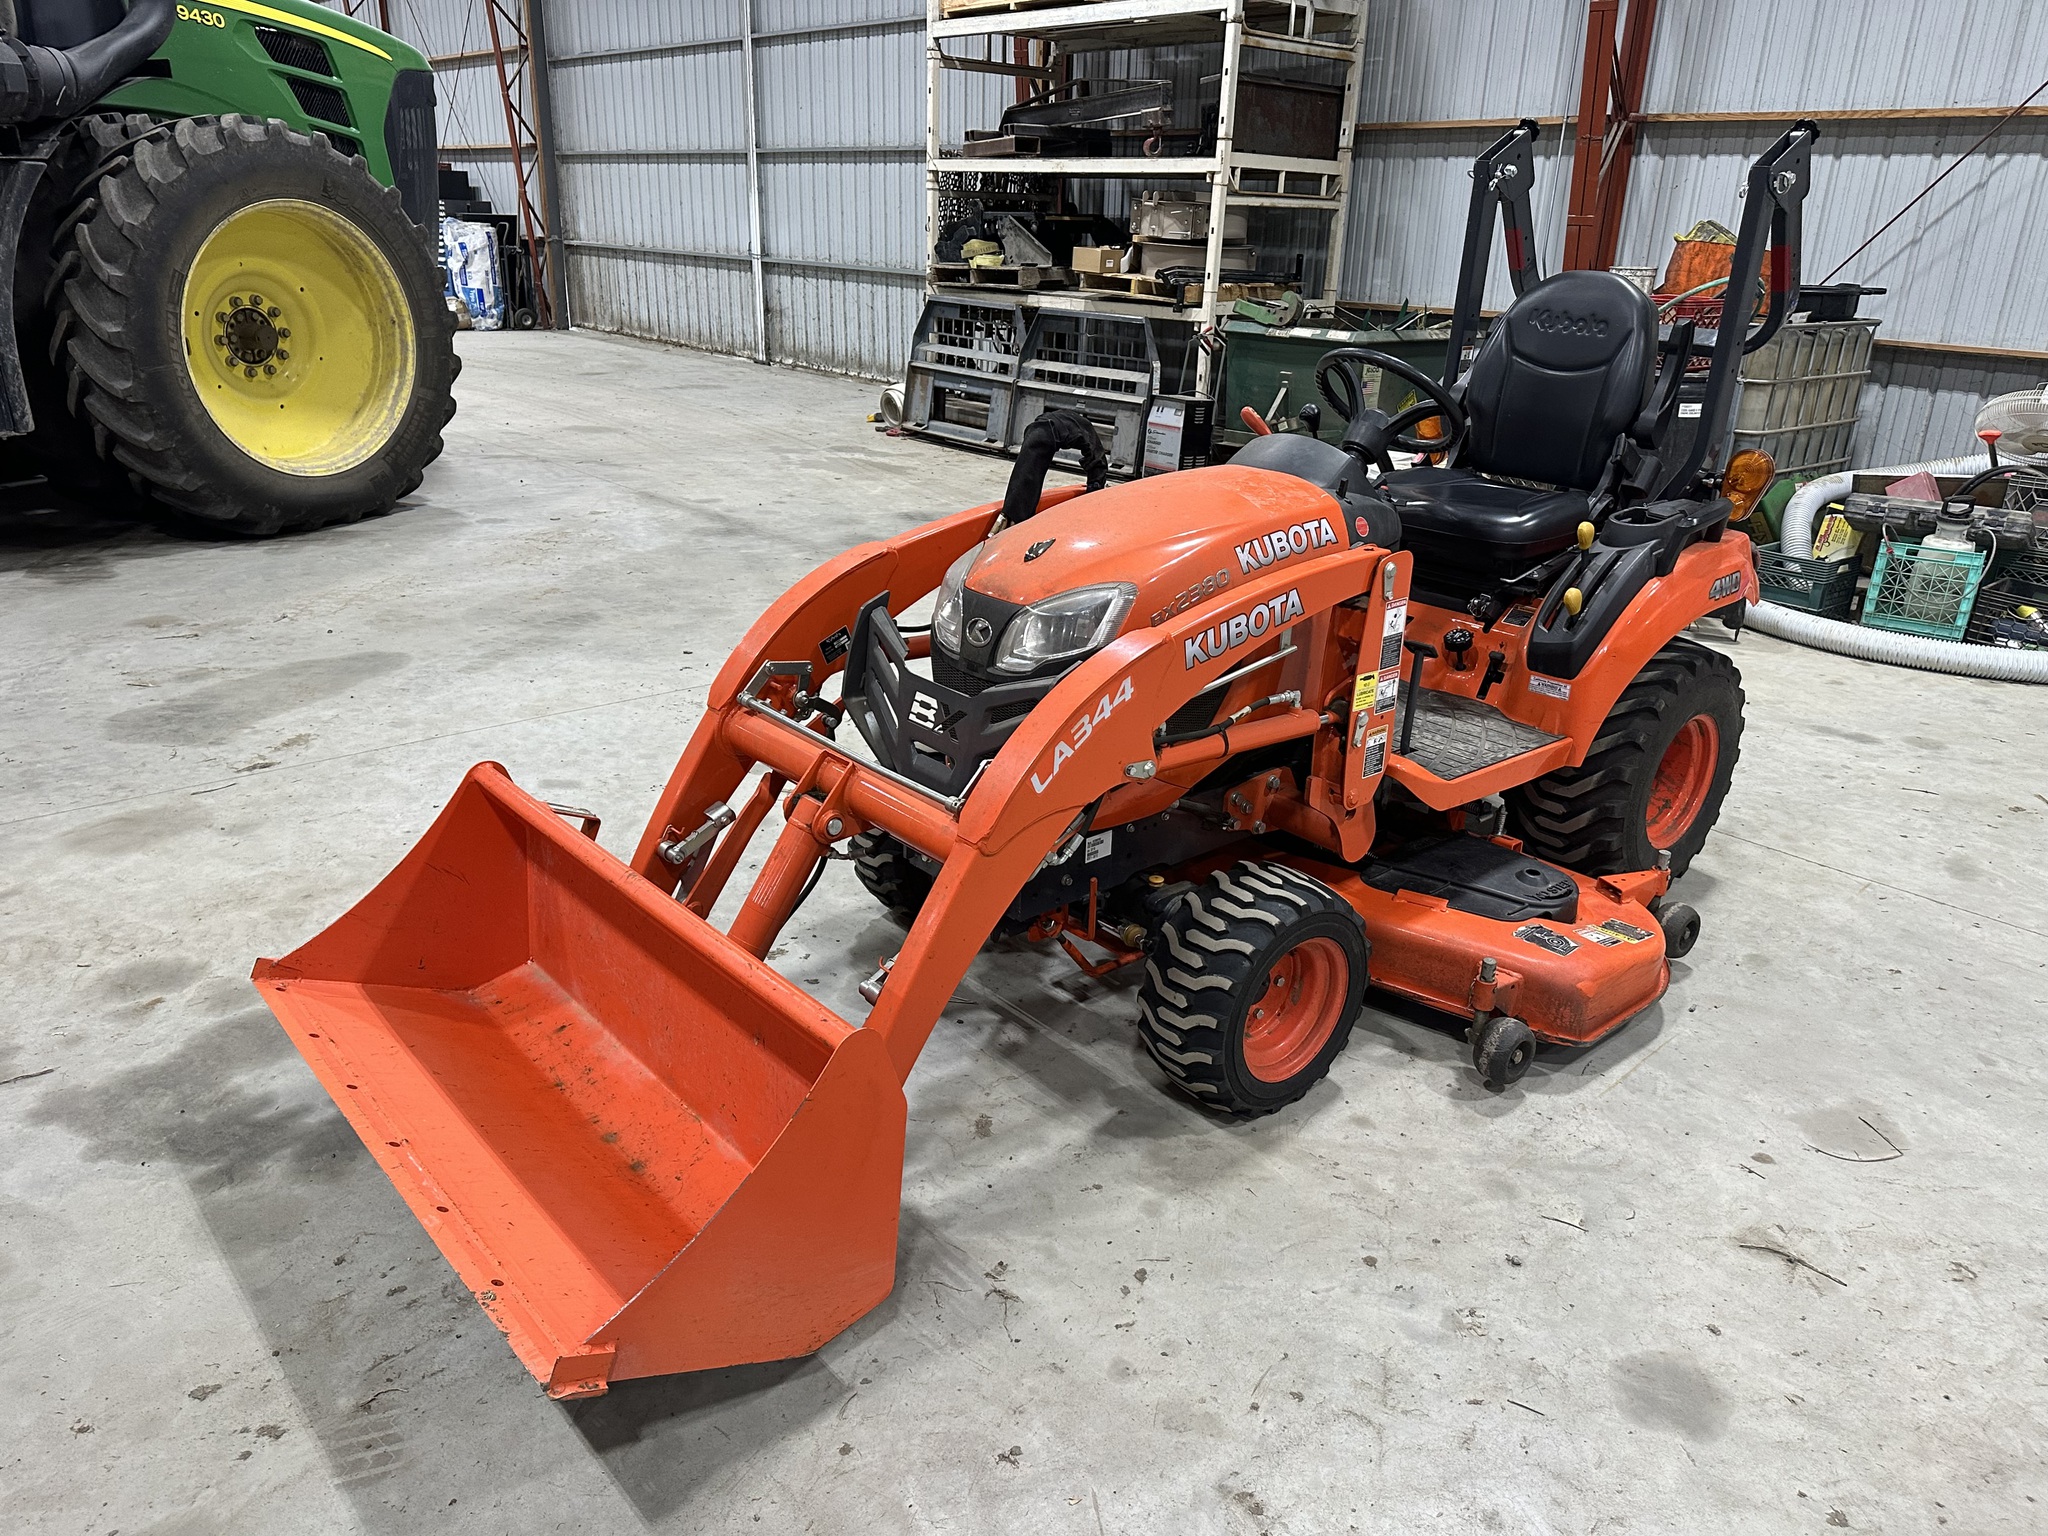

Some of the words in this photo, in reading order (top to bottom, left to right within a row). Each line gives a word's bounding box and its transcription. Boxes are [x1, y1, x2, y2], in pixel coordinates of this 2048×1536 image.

[176, 4, 226, 29] 9430
[1528, 308, 1609, 338] Kubota
[1234, 517, 1338, 575] KUBOTA
[1709, 570, 1741, 601] 4WD
[1184, 588, 1305, 671] KUBOTA
[908, 690, 968, 743] BX
[1030, 675, 1135, 794] LA344
